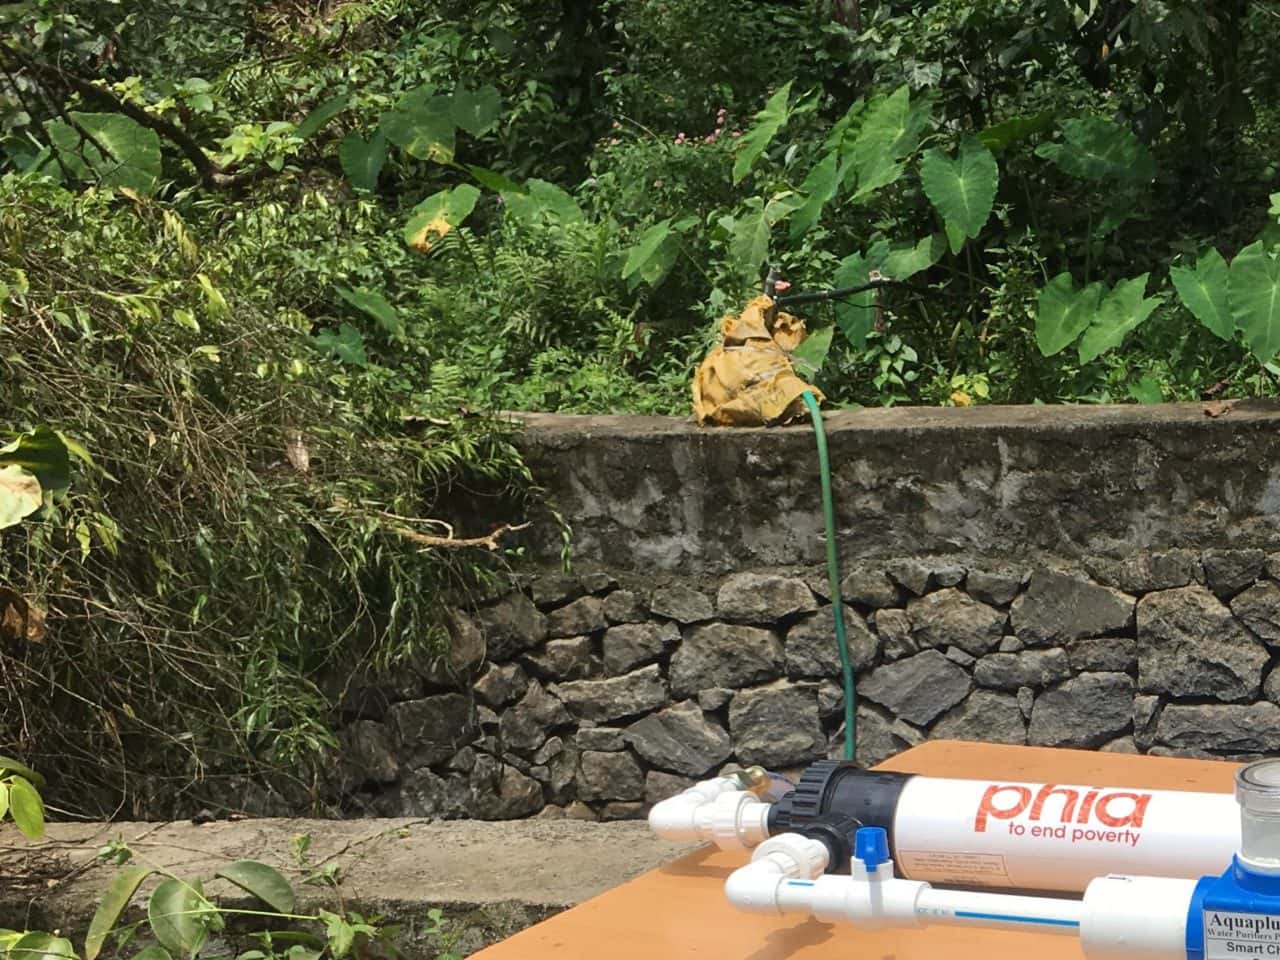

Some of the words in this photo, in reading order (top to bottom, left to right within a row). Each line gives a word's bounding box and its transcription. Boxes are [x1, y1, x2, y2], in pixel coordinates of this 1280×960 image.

[974, 784, 1152, 832] phia
[1008, 821, 1025, 836] to
[1031, 825, 1066, 839] end
[1072, 828, 1141, 847] poverty
[1207, 928, 1236, 938] Water
[1226, 942, 1263, 954] Smart
